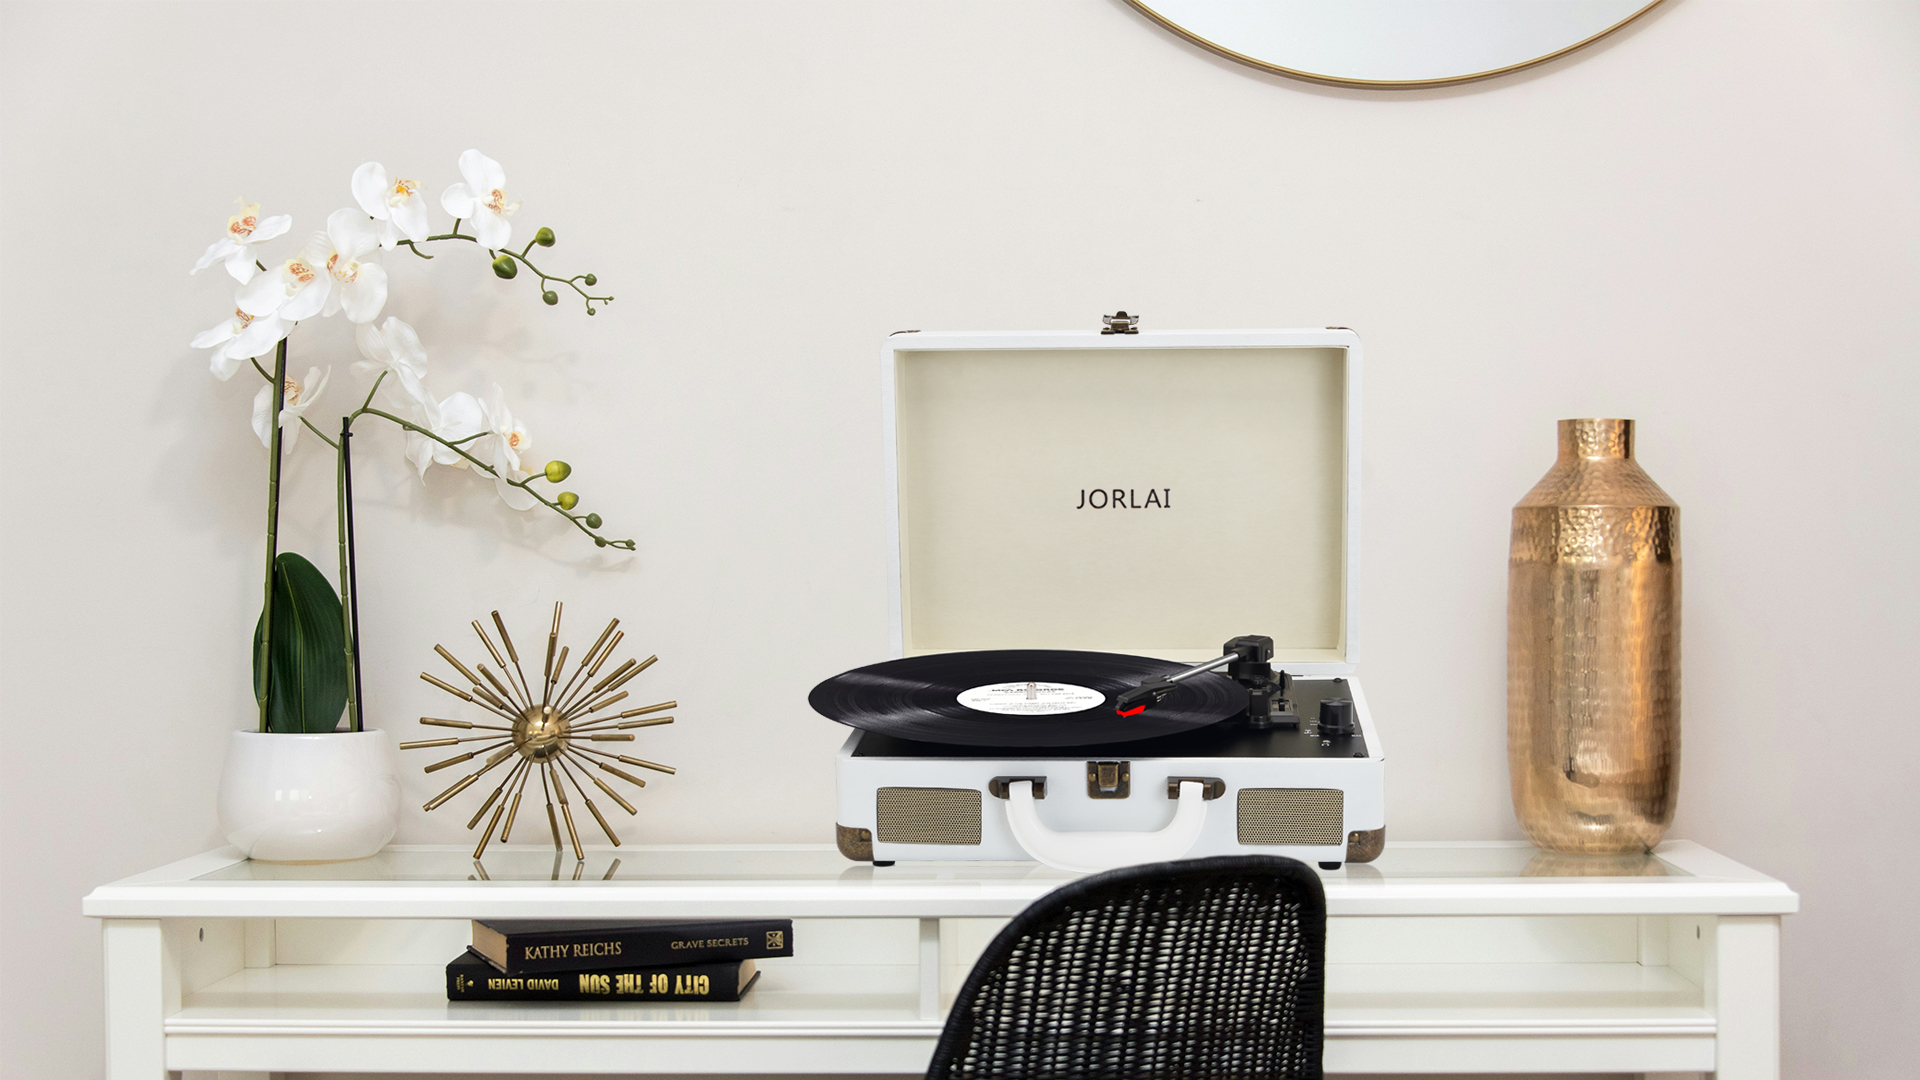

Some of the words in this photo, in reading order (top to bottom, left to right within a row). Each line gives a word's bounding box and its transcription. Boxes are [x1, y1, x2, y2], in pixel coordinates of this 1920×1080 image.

[1076, 488, 1171, 510] JORLAI
[524, 944, 570, 960] KATHY
[573, 941, 622, 957] REICHS
[670, 939, 705, 950] GRAVE
[706, 937, 750, 948] SECRETS
[487, 978, 524, 990] LEVIEN
[526, 978, 559, 990] DAVID
[578, 973, 611, 995] SUN
[615, 973, 644, 995] THE
[649, 973, 669, 994] OF
[674, 974, 710, 995] CITY
